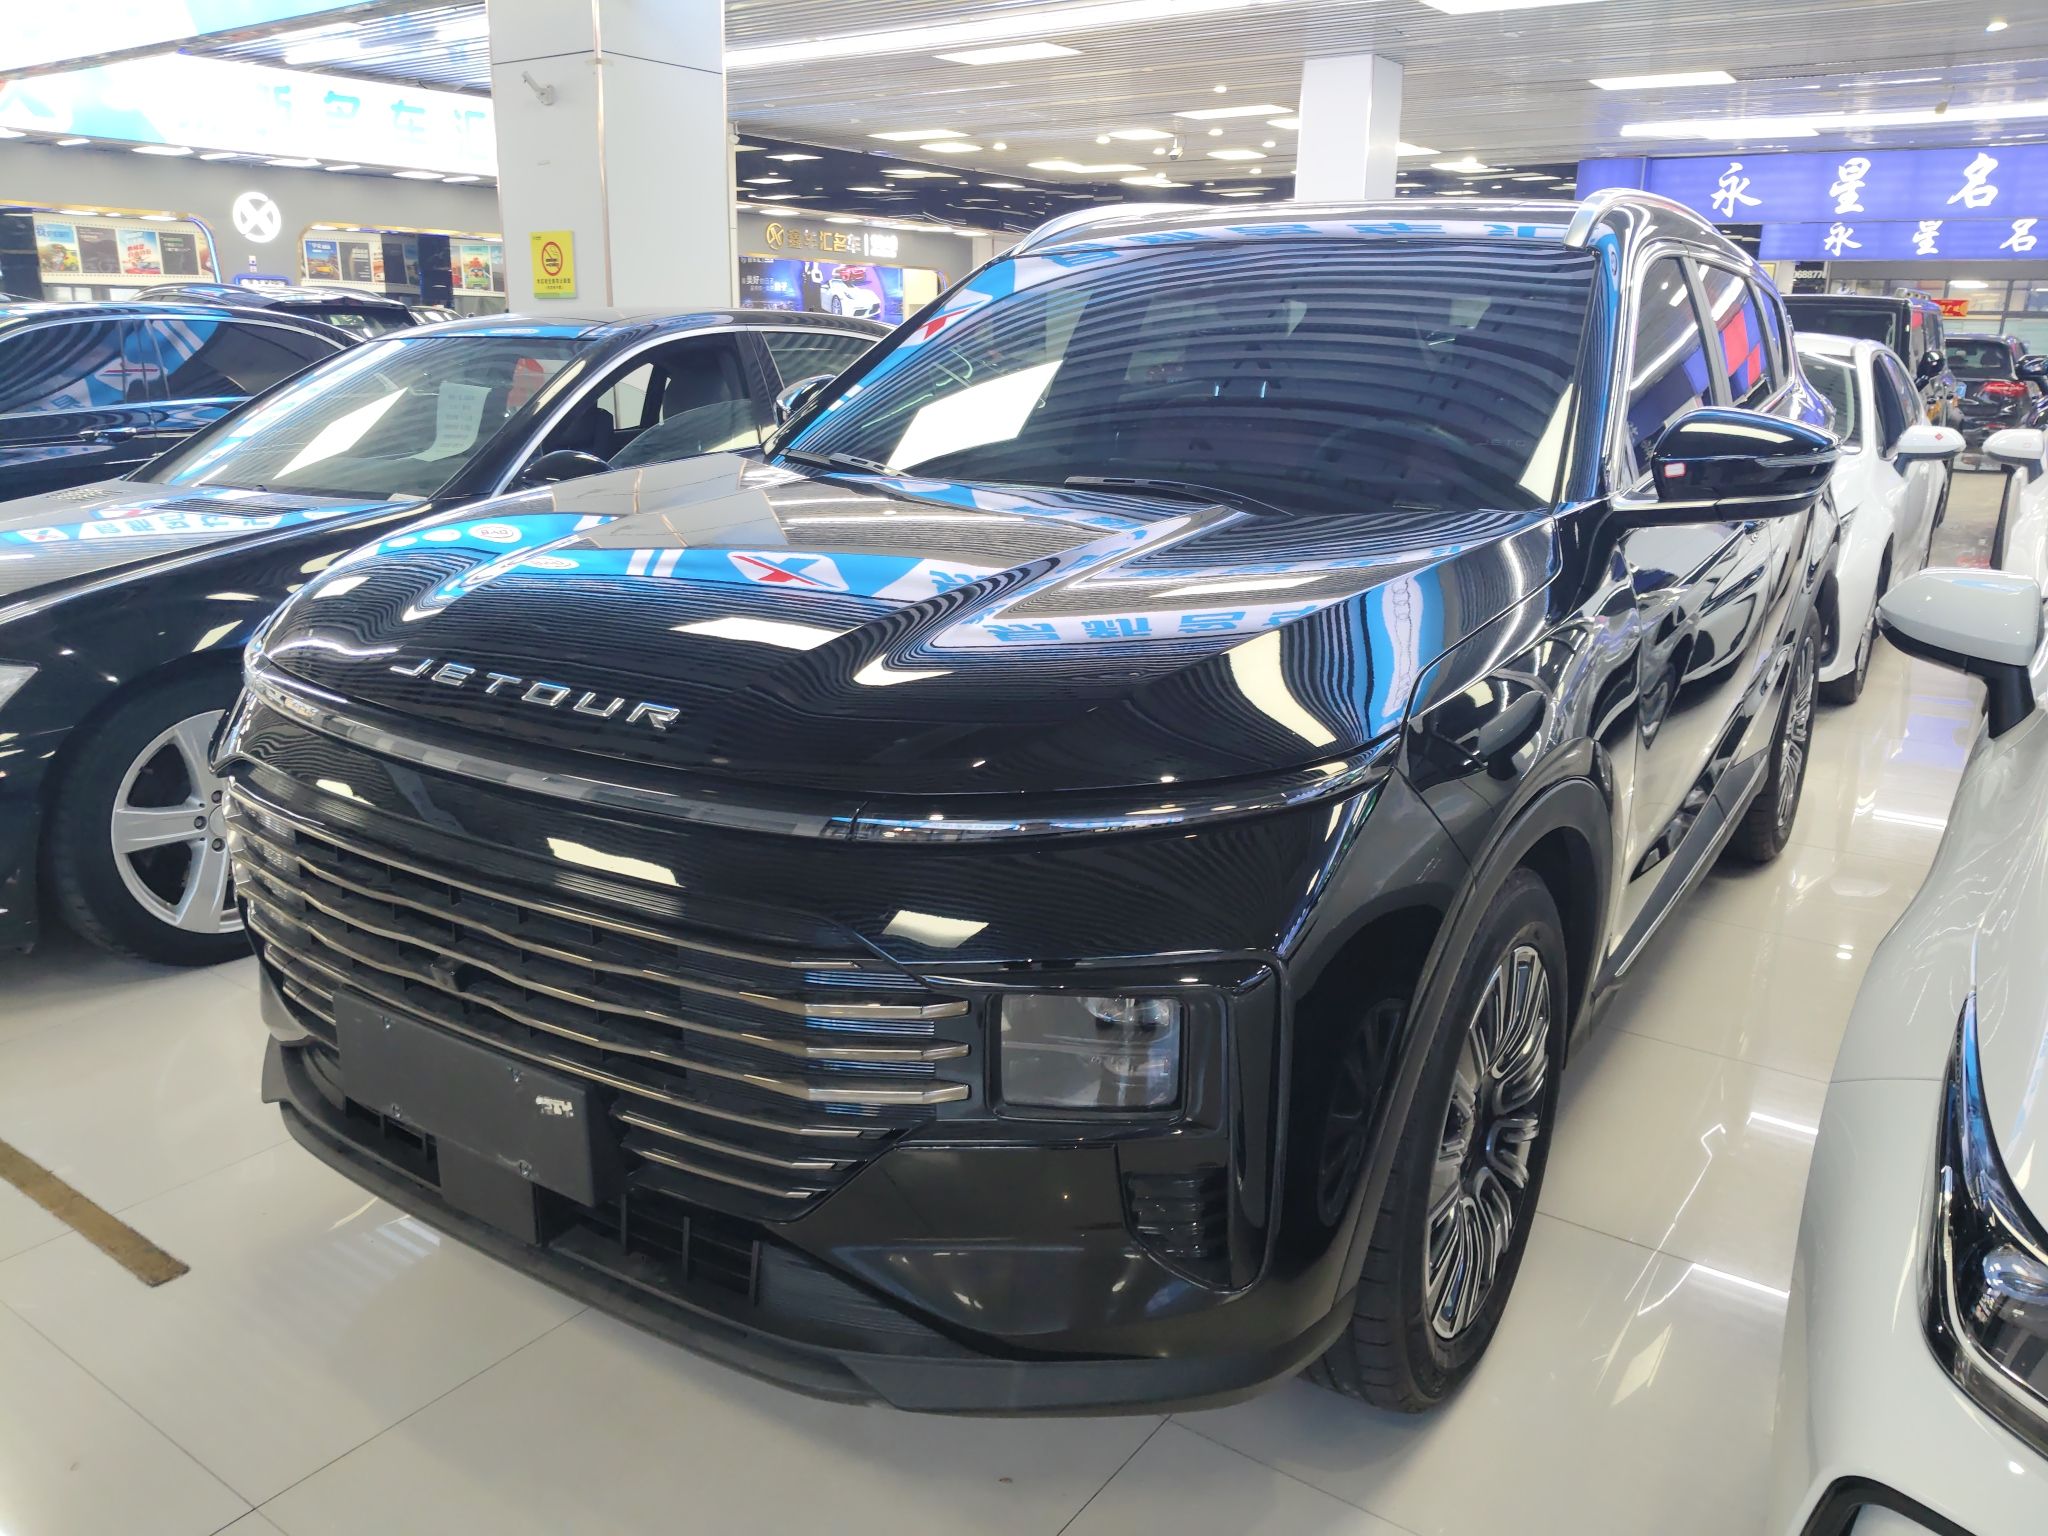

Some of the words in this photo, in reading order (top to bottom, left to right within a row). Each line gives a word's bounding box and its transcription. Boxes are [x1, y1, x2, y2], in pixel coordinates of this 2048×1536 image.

[1710, 152, 1999, 218] 永星名
[390, 658, 681, 730] JETOUR
